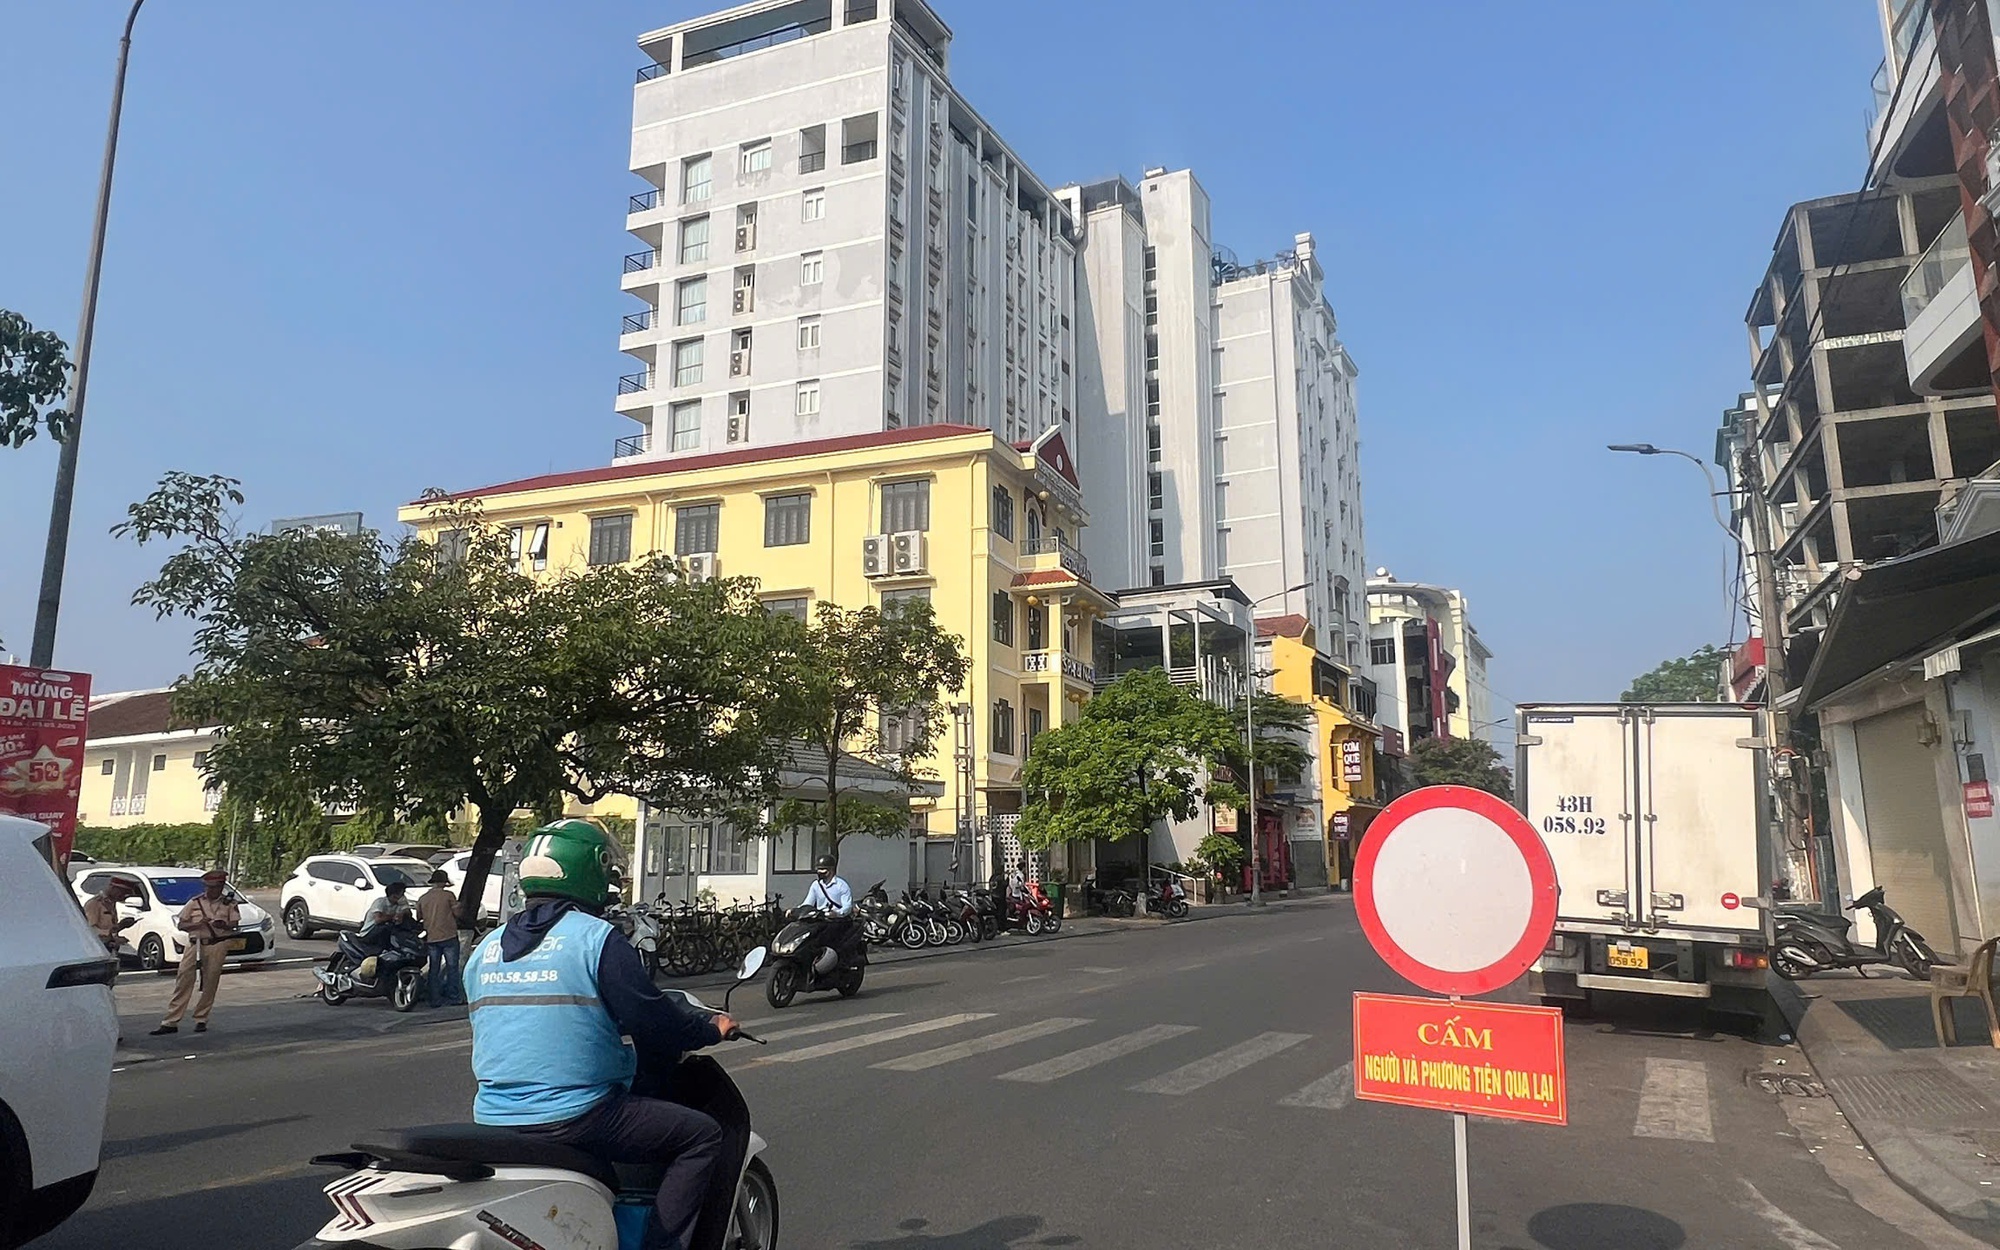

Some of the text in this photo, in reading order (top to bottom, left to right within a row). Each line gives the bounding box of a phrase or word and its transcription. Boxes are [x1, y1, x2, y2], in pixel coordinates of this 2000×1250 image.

[11, 680, 73, 699] MỪNG
[0, 695, 86, 721] ĐẠI LỄ
[1556, 795, 1593, 813] 43H
[1543, 815, 1606, 835] 058.92
[1417, 1015, 1493, 1051] CẤM
[1364, 1050, 1555, 1108] NGƯỜI VÀ PHƯƠNG TIỆN QUA LẠI
